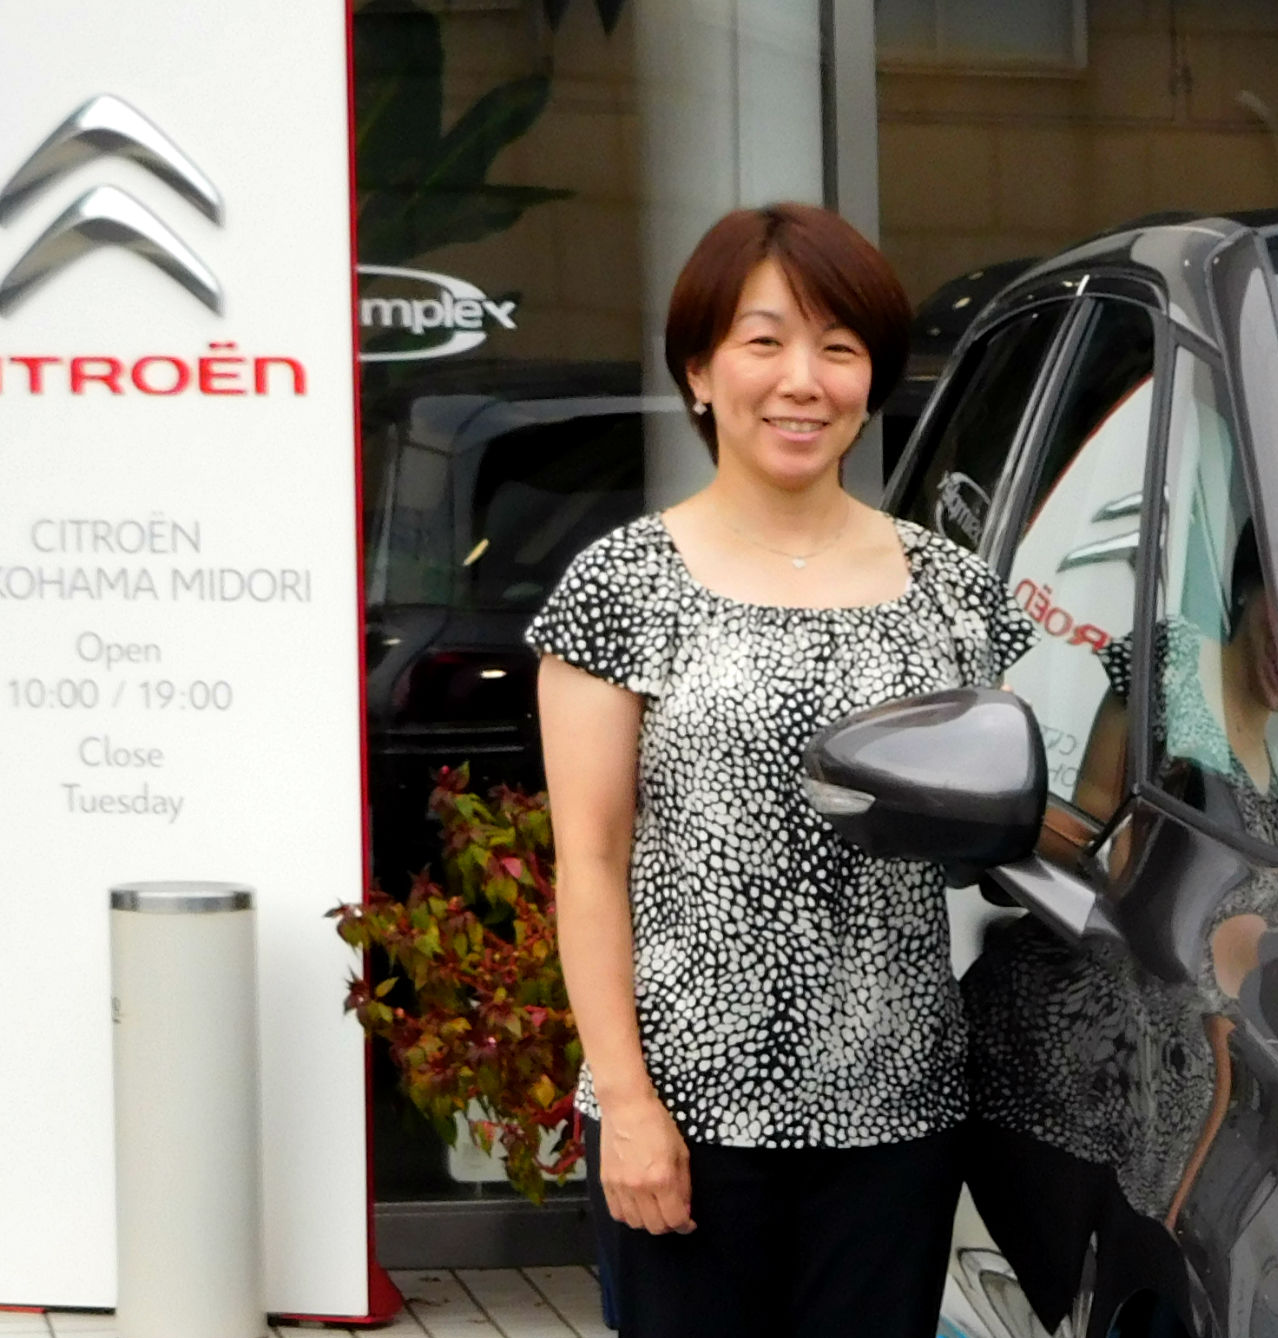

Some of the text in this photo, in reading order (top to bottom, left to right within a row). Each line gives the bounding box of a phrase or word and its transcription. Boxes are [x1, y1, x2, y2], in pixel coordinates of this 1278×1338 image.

[360, 288, 518, 334] mplex
[30, 511, 201, 554] CITROËN
[171, 567, 312, 603] MIDORI
[75, 631, 162, 670] Open
[8, 678, 100, 710] 10:00
[139, 679, 234, 711] 19:00
[78, 735, 165, 768] Close
[61, 782, 184, 824] Tuesday
